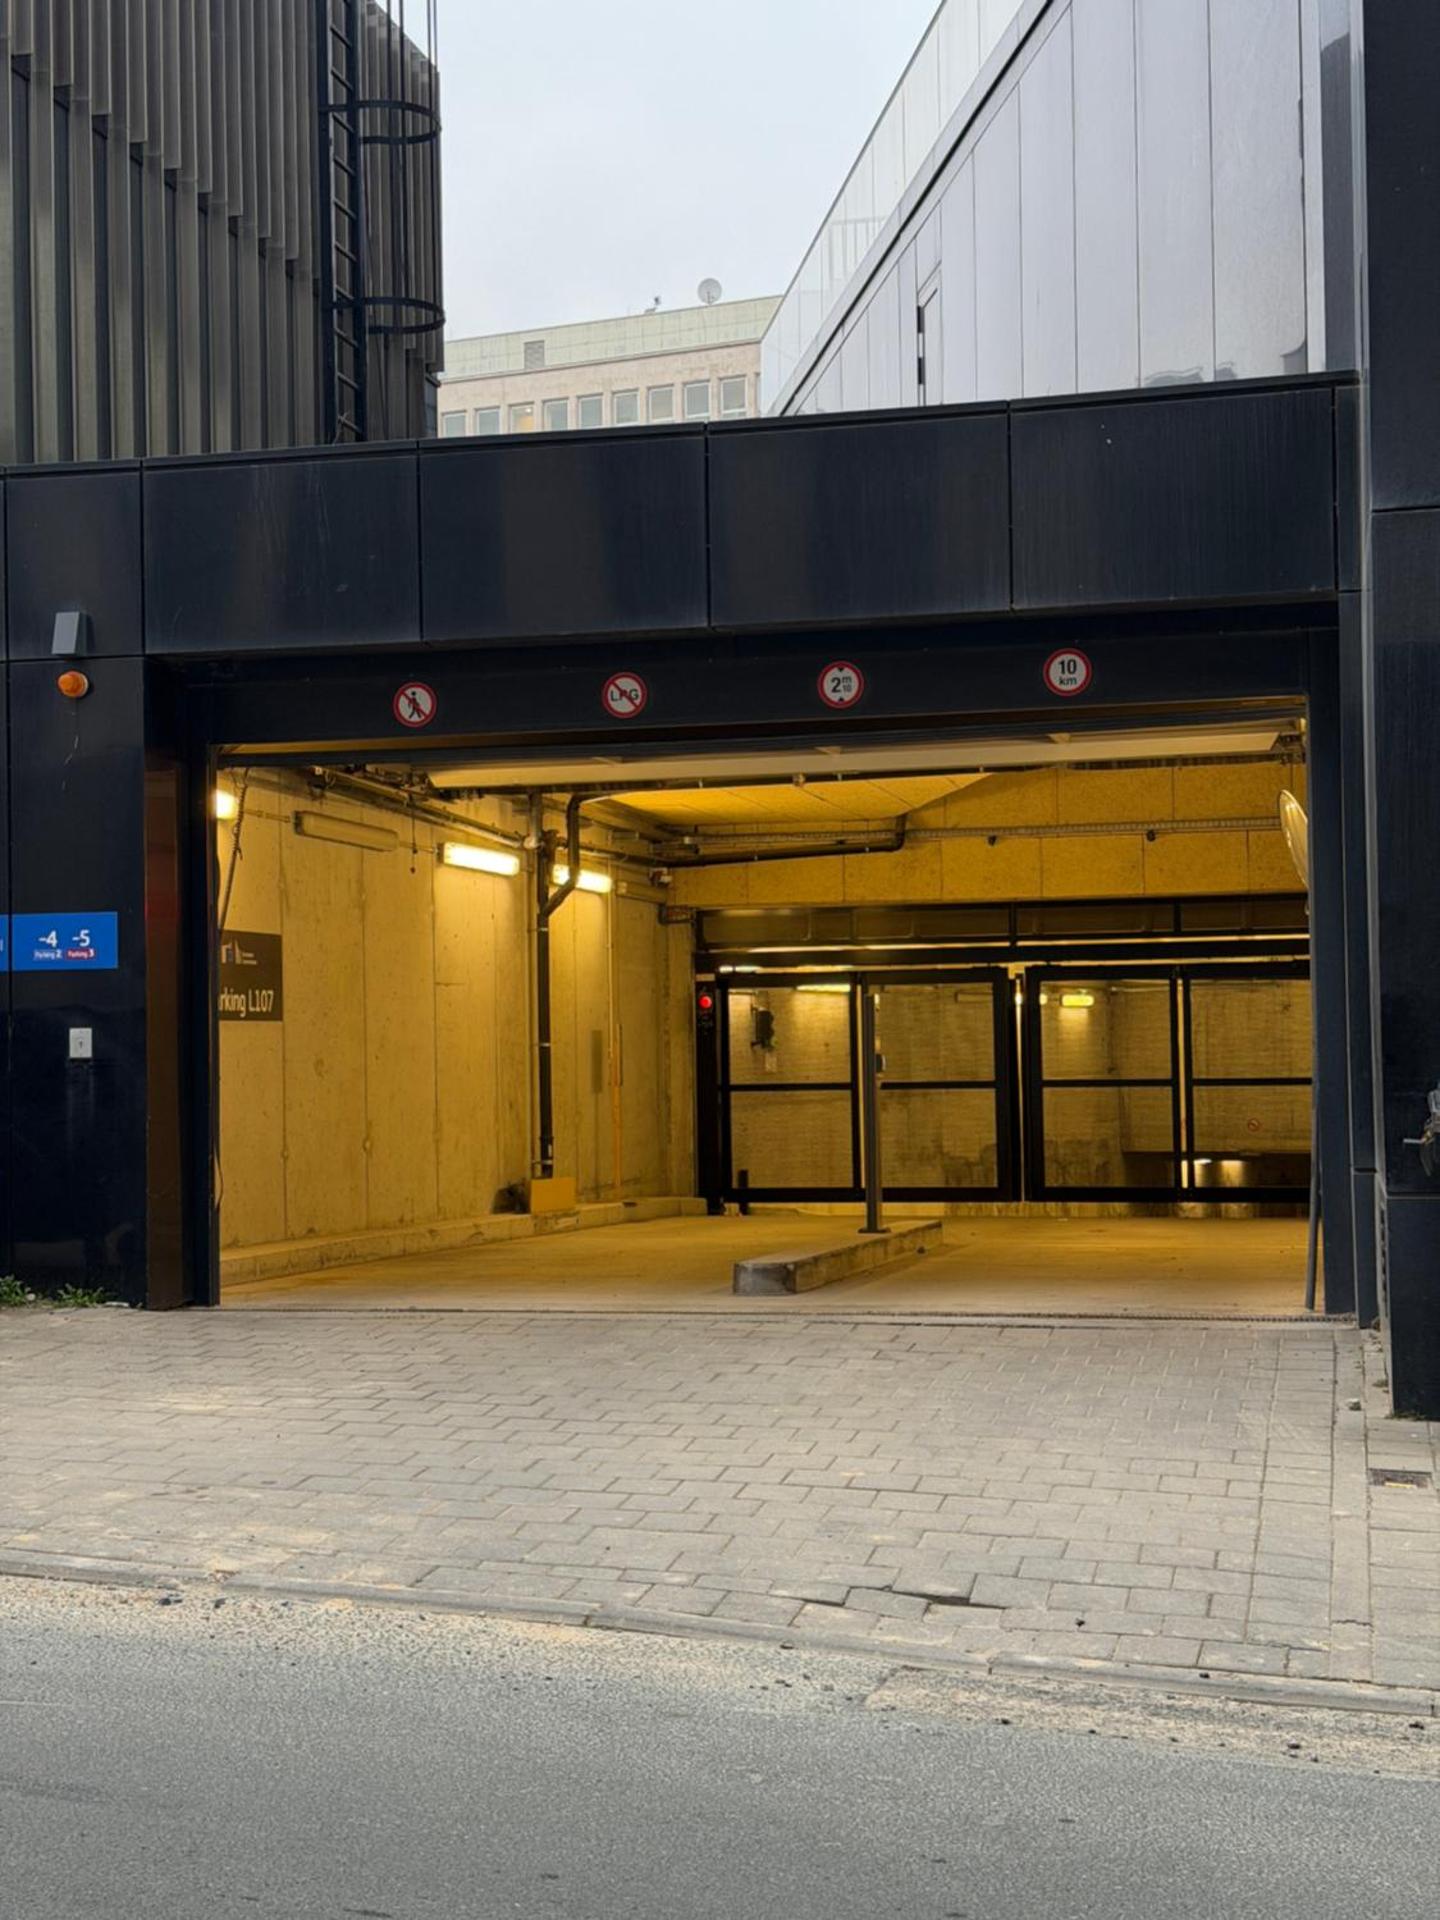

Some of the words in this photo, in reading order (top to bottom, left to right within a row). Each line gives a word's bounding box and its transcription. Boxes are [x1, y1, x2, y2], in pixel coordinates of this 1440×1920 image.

[1059, 659, 1077, 675] 10
[831, 677, 841, 693] 2
[1059, 676, 1077, 686] km
[38, 930, 58, 947] -4
[72, 929, 91, 947] -5
[248, 989, 274, 1013] L107
